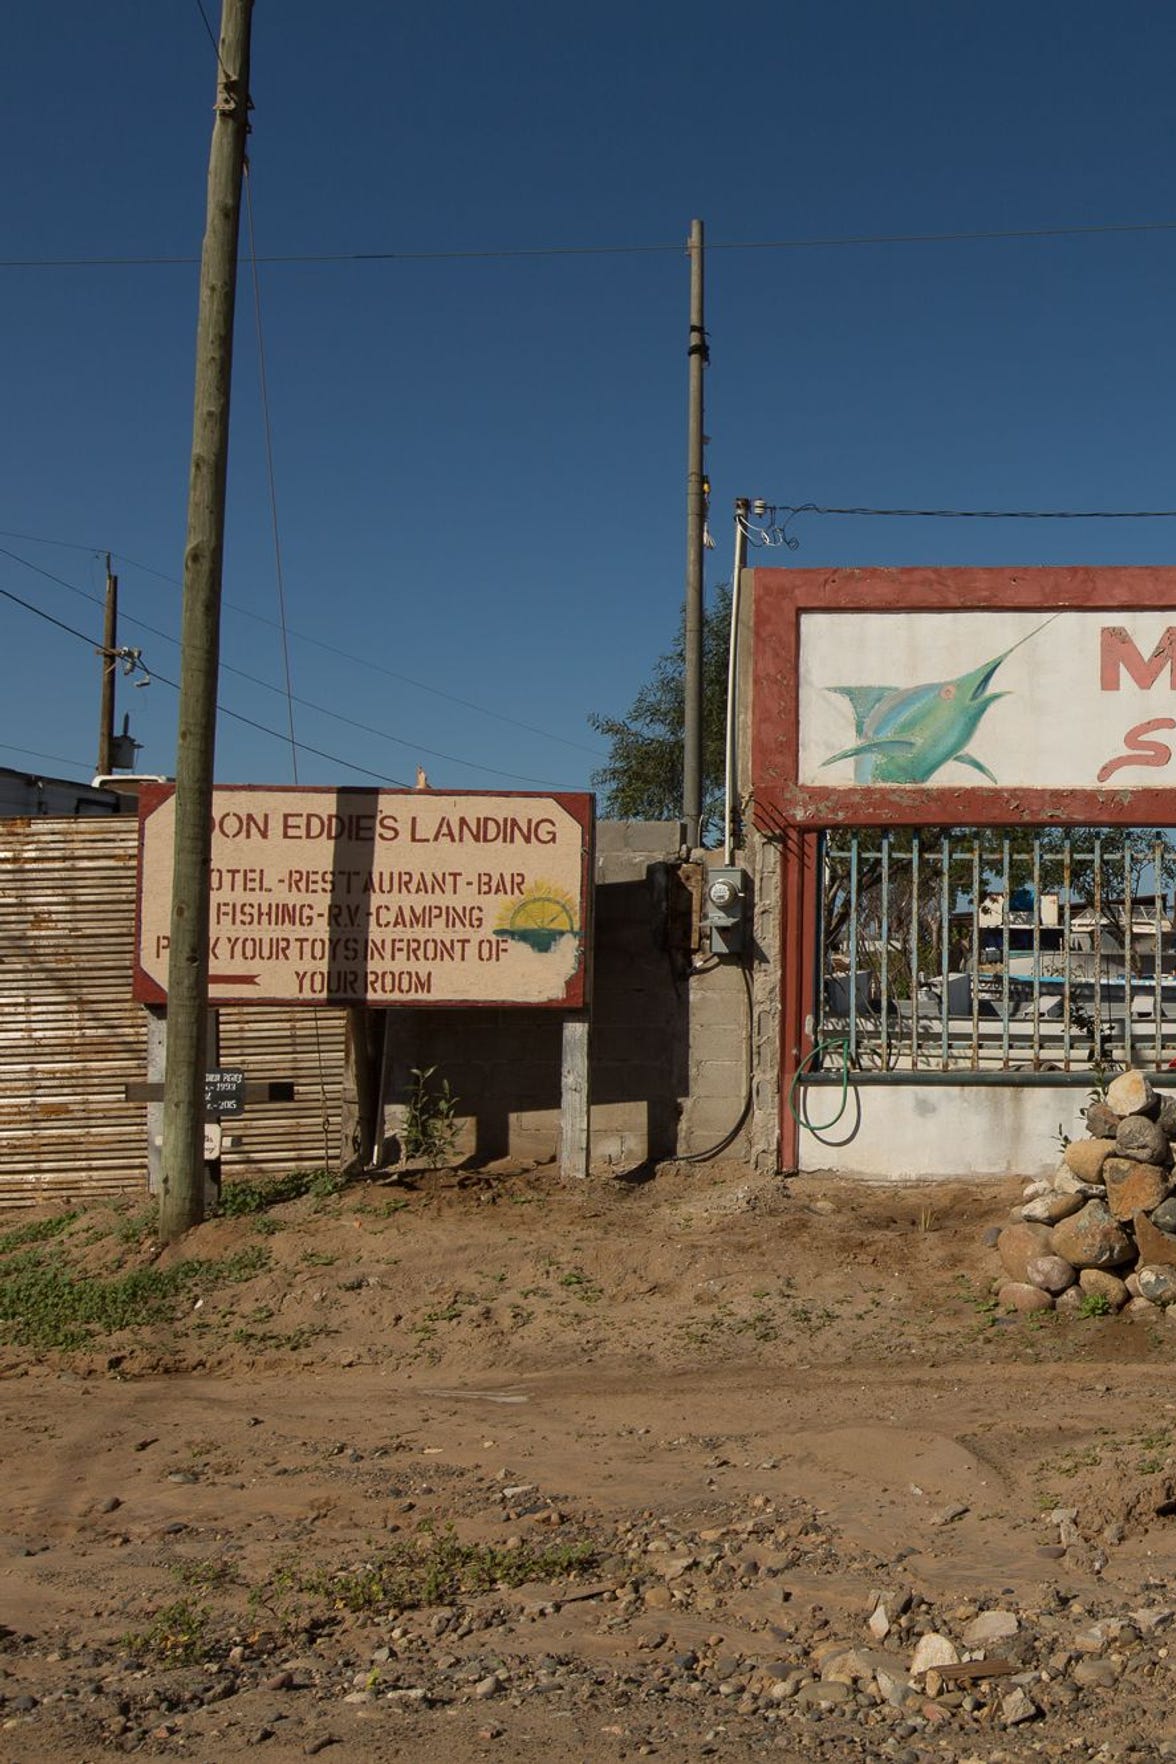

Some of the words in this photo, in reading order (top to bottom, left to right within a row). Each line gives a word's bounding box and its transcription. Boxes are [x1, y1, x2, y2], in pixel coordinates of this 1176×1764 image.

[210, 812, 269, 840] ON
[282, 809, 400, 842] EDDIE'S
[410, 816, 558, 845] LANDING
[226, 937, 291, 961] YOUR
[294, 937, 360, 962] TOYS
[363, 938, 386, 962] IN
[390, 938, 471, 962] FRONT
[477, 939, 510, 963] OF
[294, 970, 360, 994] YOUR
[363, 970, 433, 994] ROOM
